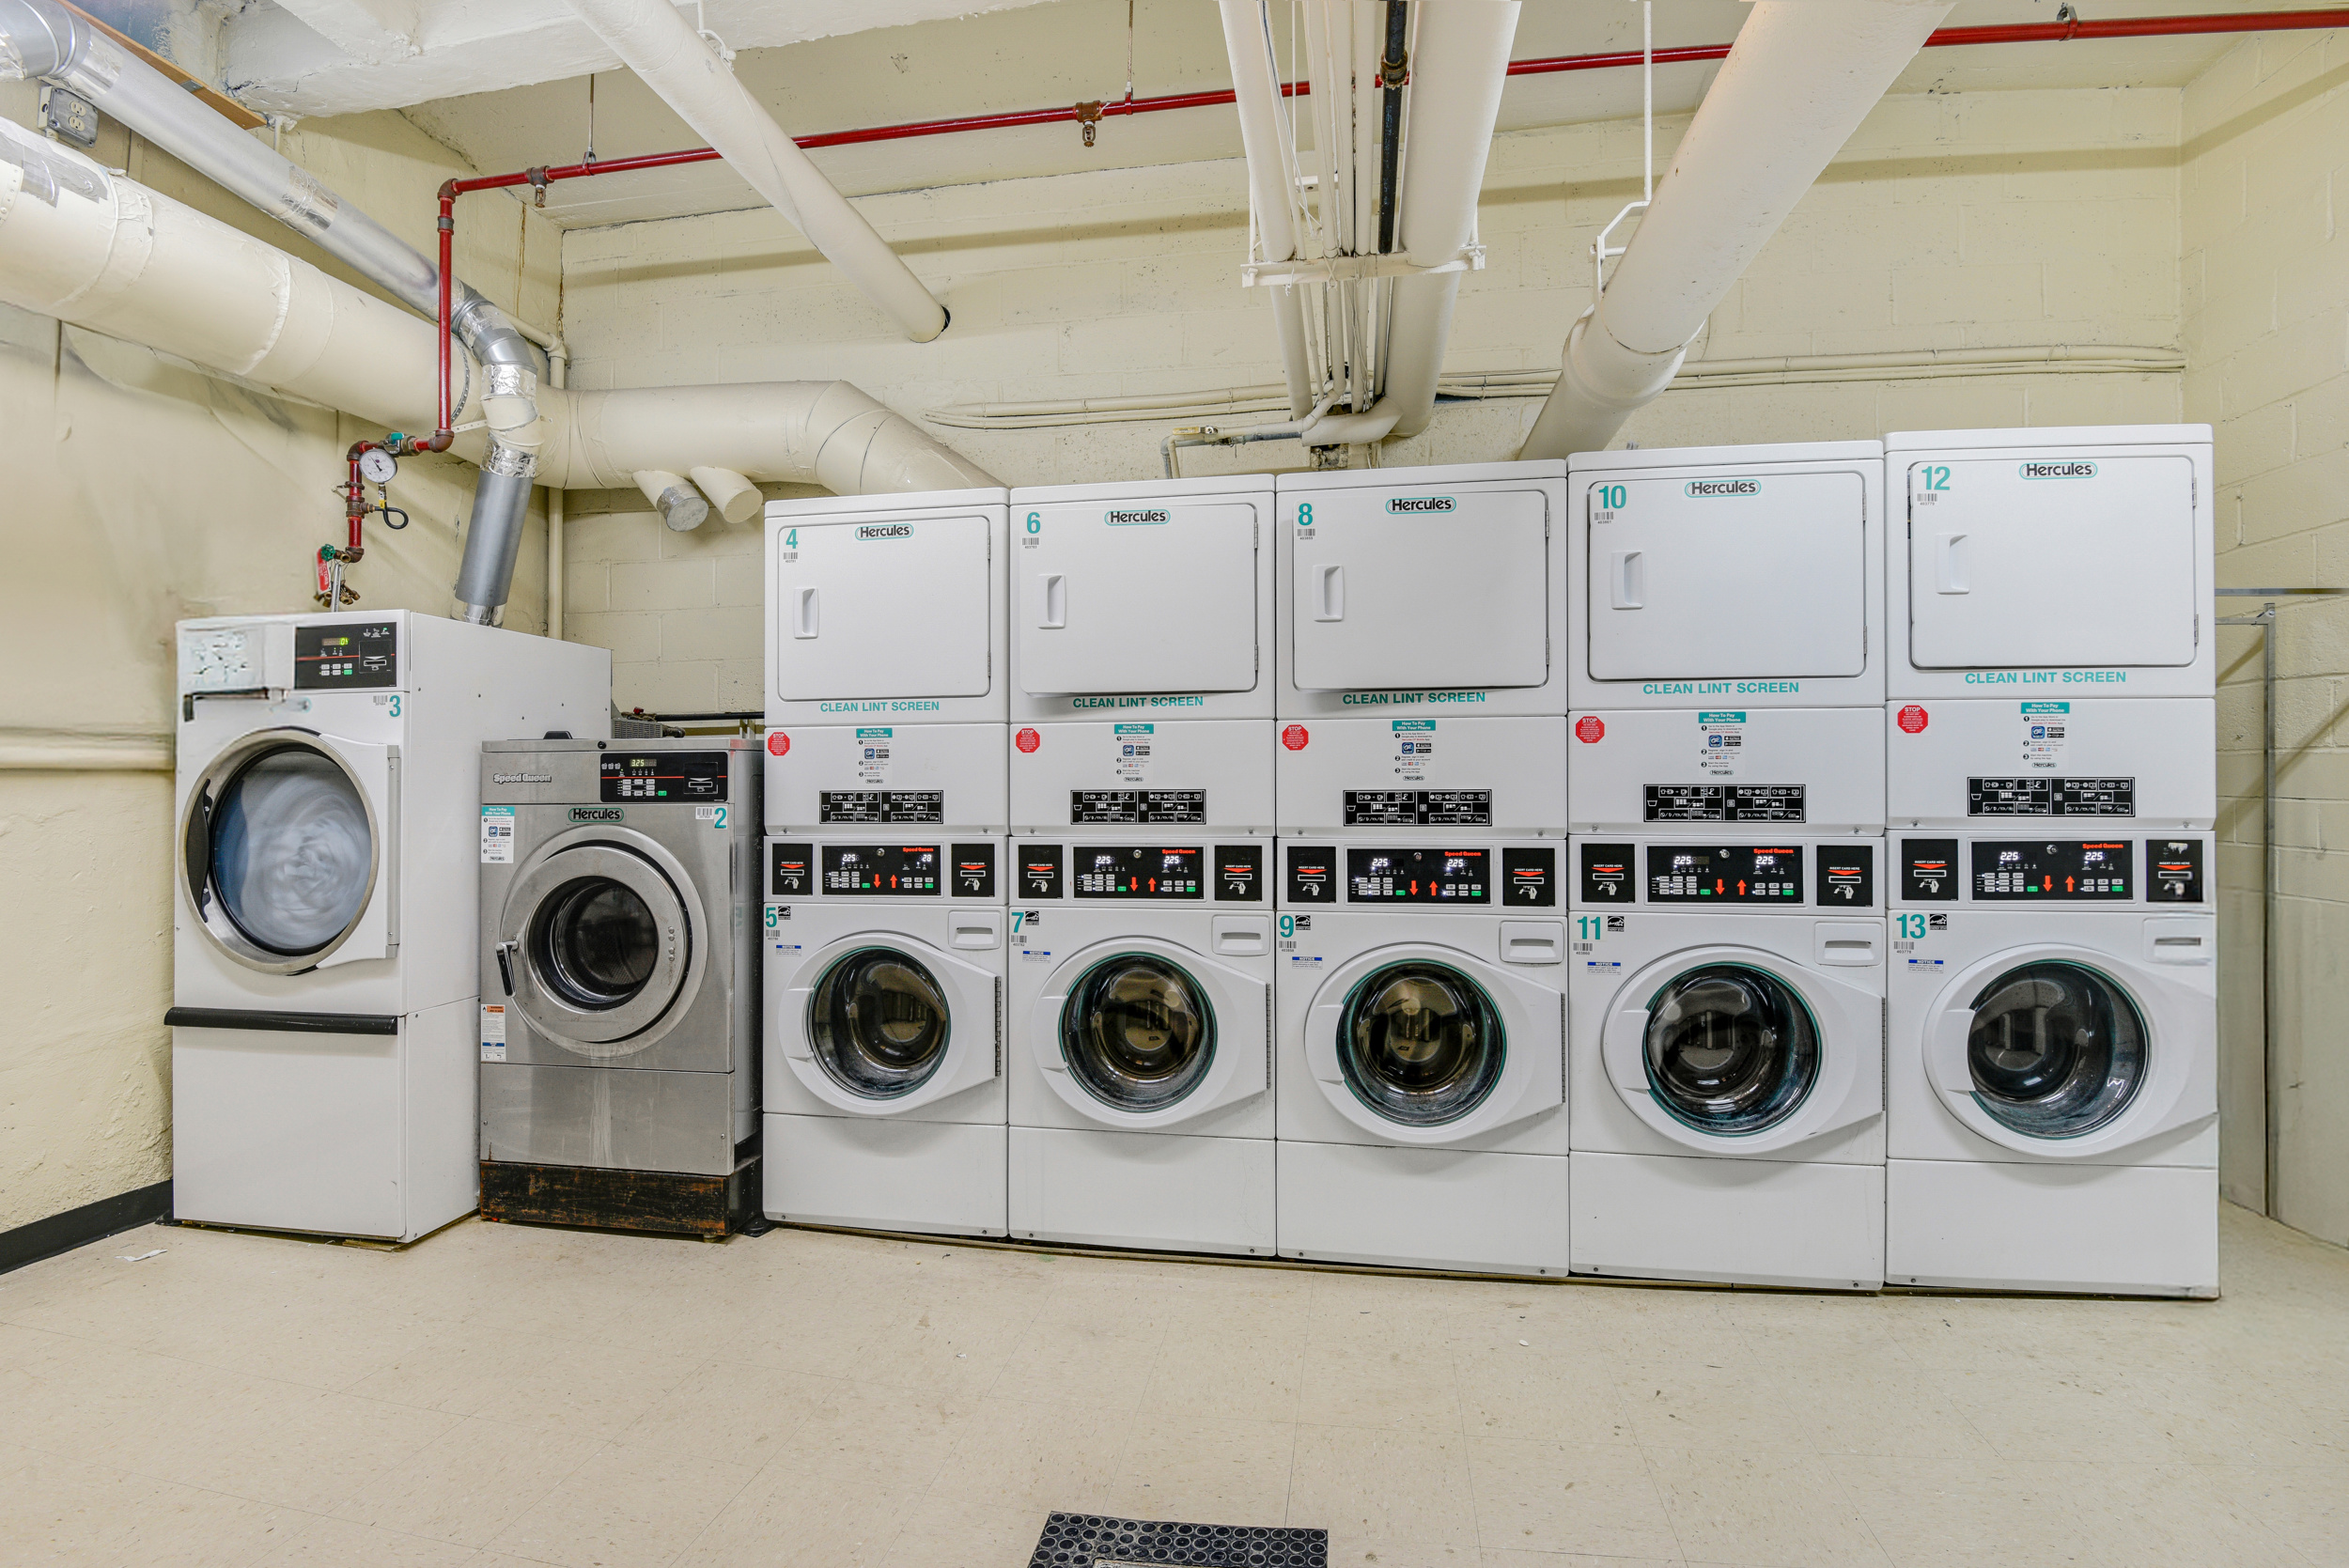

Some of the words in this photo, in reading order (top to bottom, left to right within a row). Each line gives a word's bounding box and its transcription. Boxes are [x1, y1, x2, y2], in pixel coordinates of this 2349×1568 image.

[1921, 466, 1950, 490] 12
[2027, 463, 2092, 477] Hercules
[1692, 481, 1756, 494] Hercules
[1392, 498, 1451, 511] Hercules
[1598, 485, 1626, 509] 10
[1027, 512, 1041, 534] 6
[1110, 511, 1166, 523] Hercules
[1298, 503, 1313, 526] 8
[786, 529, 798, 549] 4
[860, 525, 909, 538] Hercules
[1965, 673, 2017, 684] CLEAN
[2023, 673, 2057, 683] LINT
[2062, 671, 2126, 682] SCREEN
[1643, 684, 1692, 695] CLEAN
[1699, 684, 1731, 694] LINT
[1736, 682, 1799, 693] SCREEN
[389, 695, 401, 717] 3
[820, 703, 858, 712] CLEAN
[863, 702, 887, 711] LINT
[891, 701, 939, 711] SCREEN
[1073, 698, 1115, 708] CLEAN
[1119, 698, 1147, 707] LINT
[1151, 697, 1203, 706] SCREEN
[1343, 694, 1388, 704] CLEAN
[1393, 693, 1423, 703] LINT
[1428, 692, 1485, 703] SCREEN
[494, 773, 522, 784] Speed
[523, 773, 552, 783] Queen
[573, 808, 620, 820] Hercules
[715, 808, 726, 828] 2
[766, 907, 777, 927] 5
[1012, 912, 1024, 933] 7
[1280, 916, 1294, 938] 9
[1577, 916, 1600, 940] 11
[1896, 914, 1926, 939] 13
